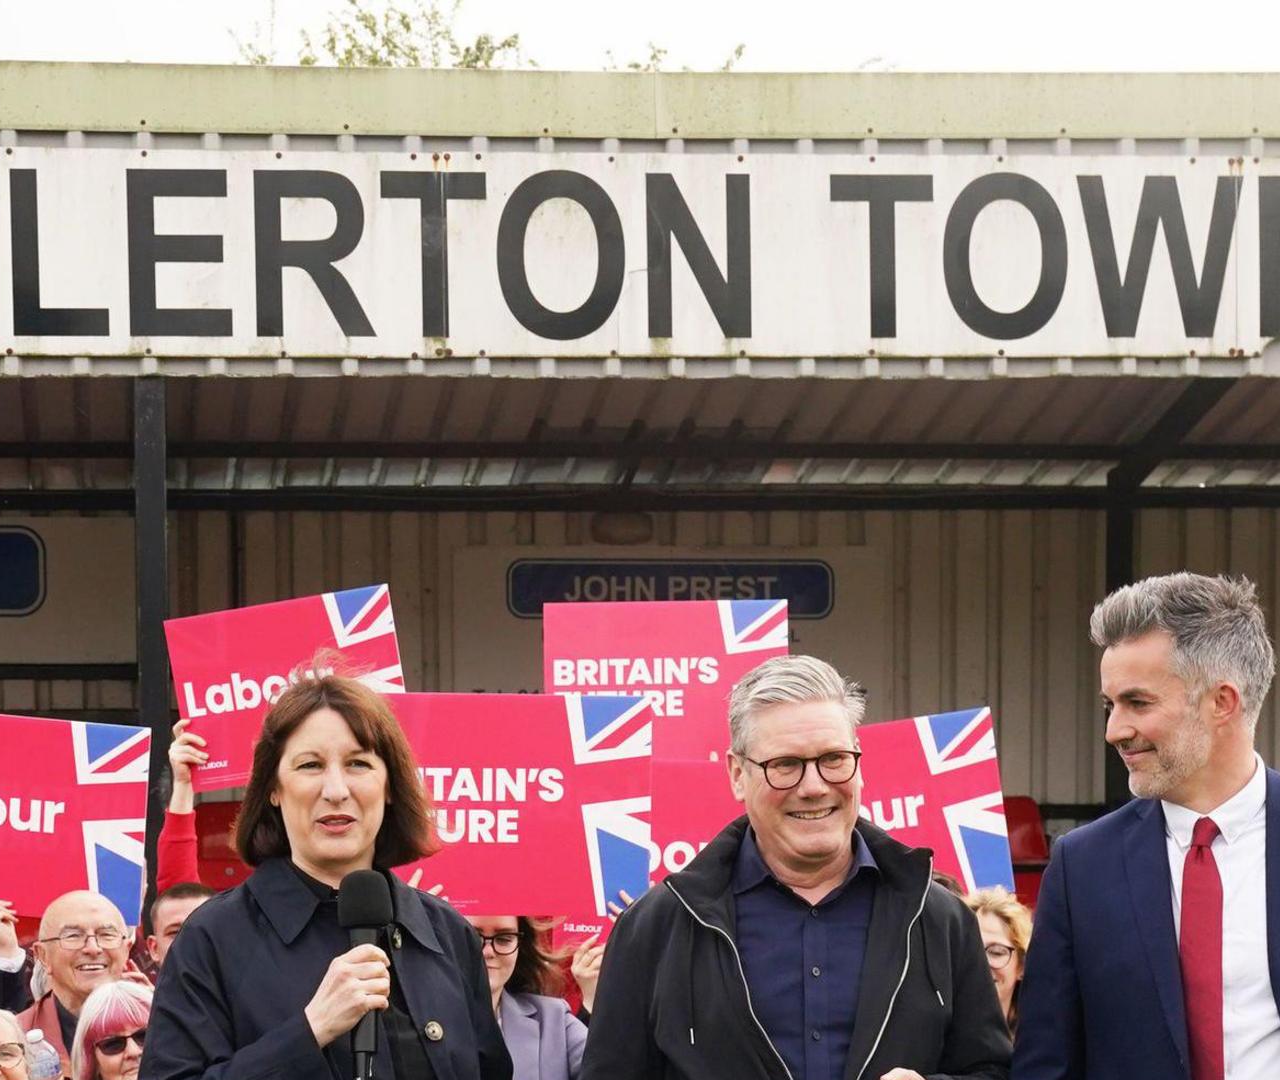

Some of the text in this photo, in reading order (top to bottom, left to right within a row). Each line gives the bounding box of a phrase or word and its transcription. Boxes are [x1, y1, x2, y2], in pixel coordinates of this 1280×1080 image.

[564, 575, 778, 602] JOHN PREST
[553, 656, 720, 687] BRITAIN'S
